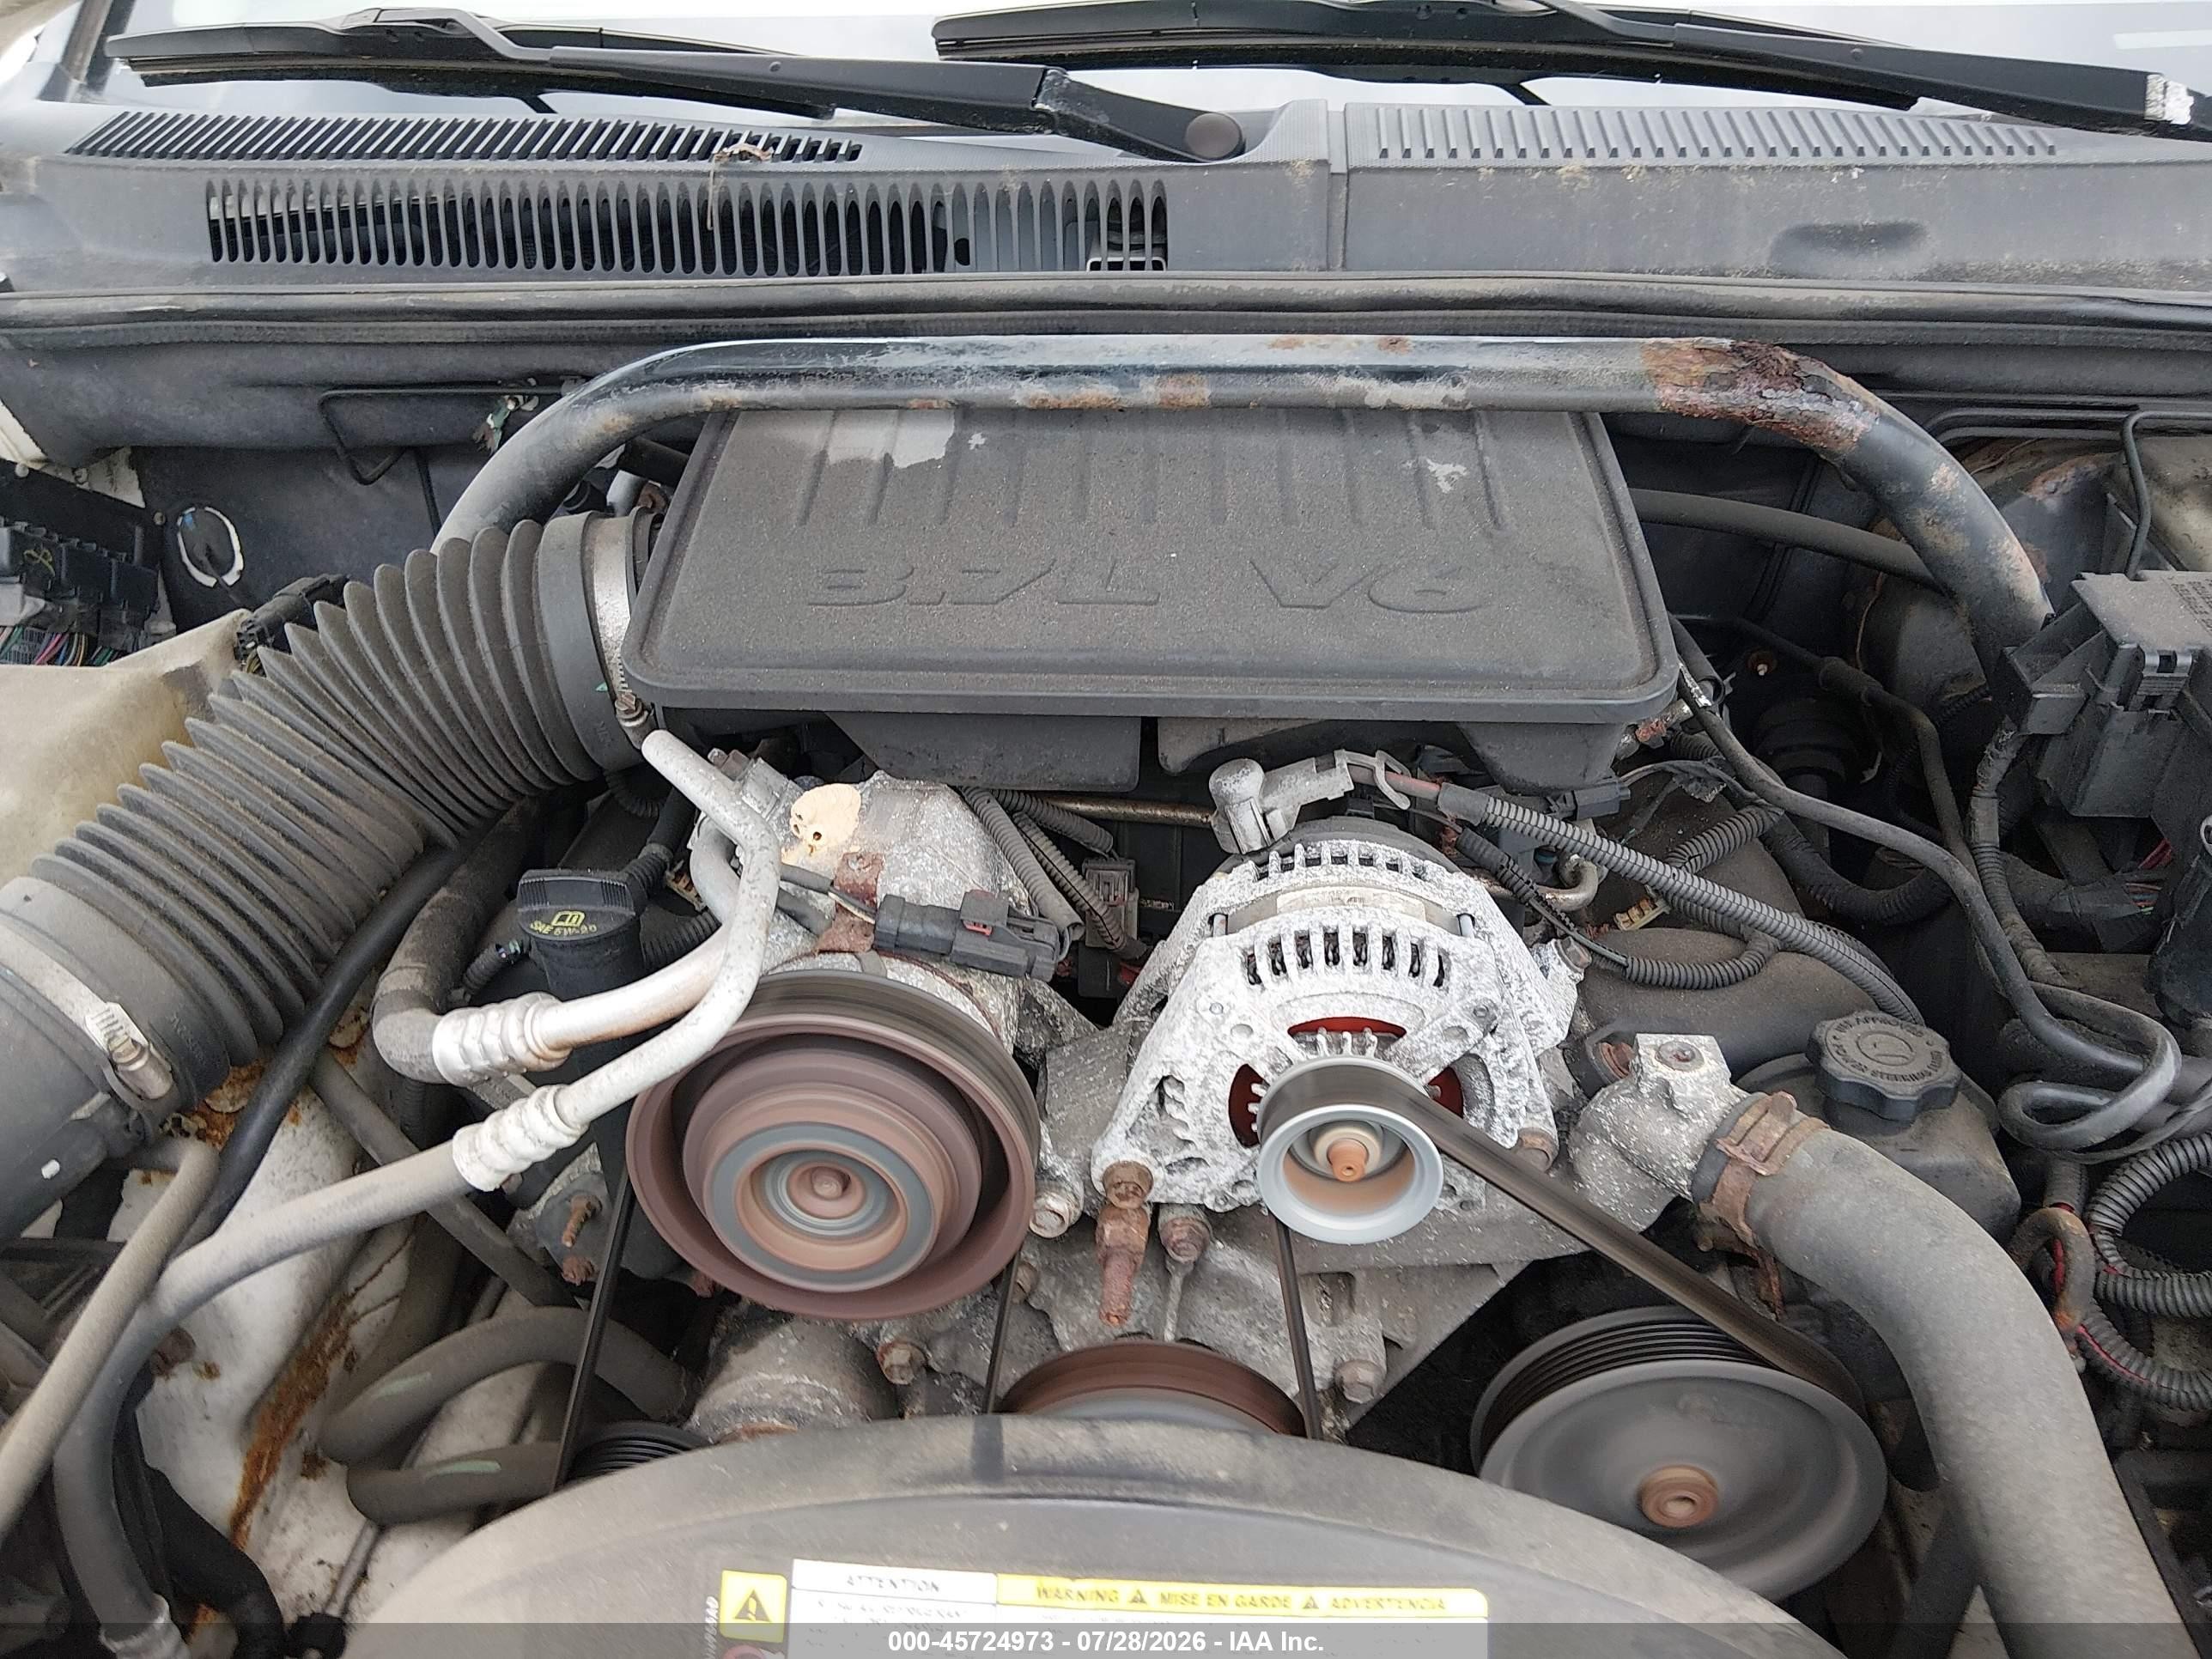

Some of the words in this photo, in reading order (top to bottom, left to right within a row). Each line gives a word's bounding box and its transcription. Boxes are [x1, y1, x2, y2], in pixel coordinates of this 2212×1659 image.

[530, 921, 554, 934] SAE
[1035, 1583, 1120, 1603] WARNING
[1159, 1592, 1199, 1607] MISE
[1206, 1593, 1230, 1608] EN
